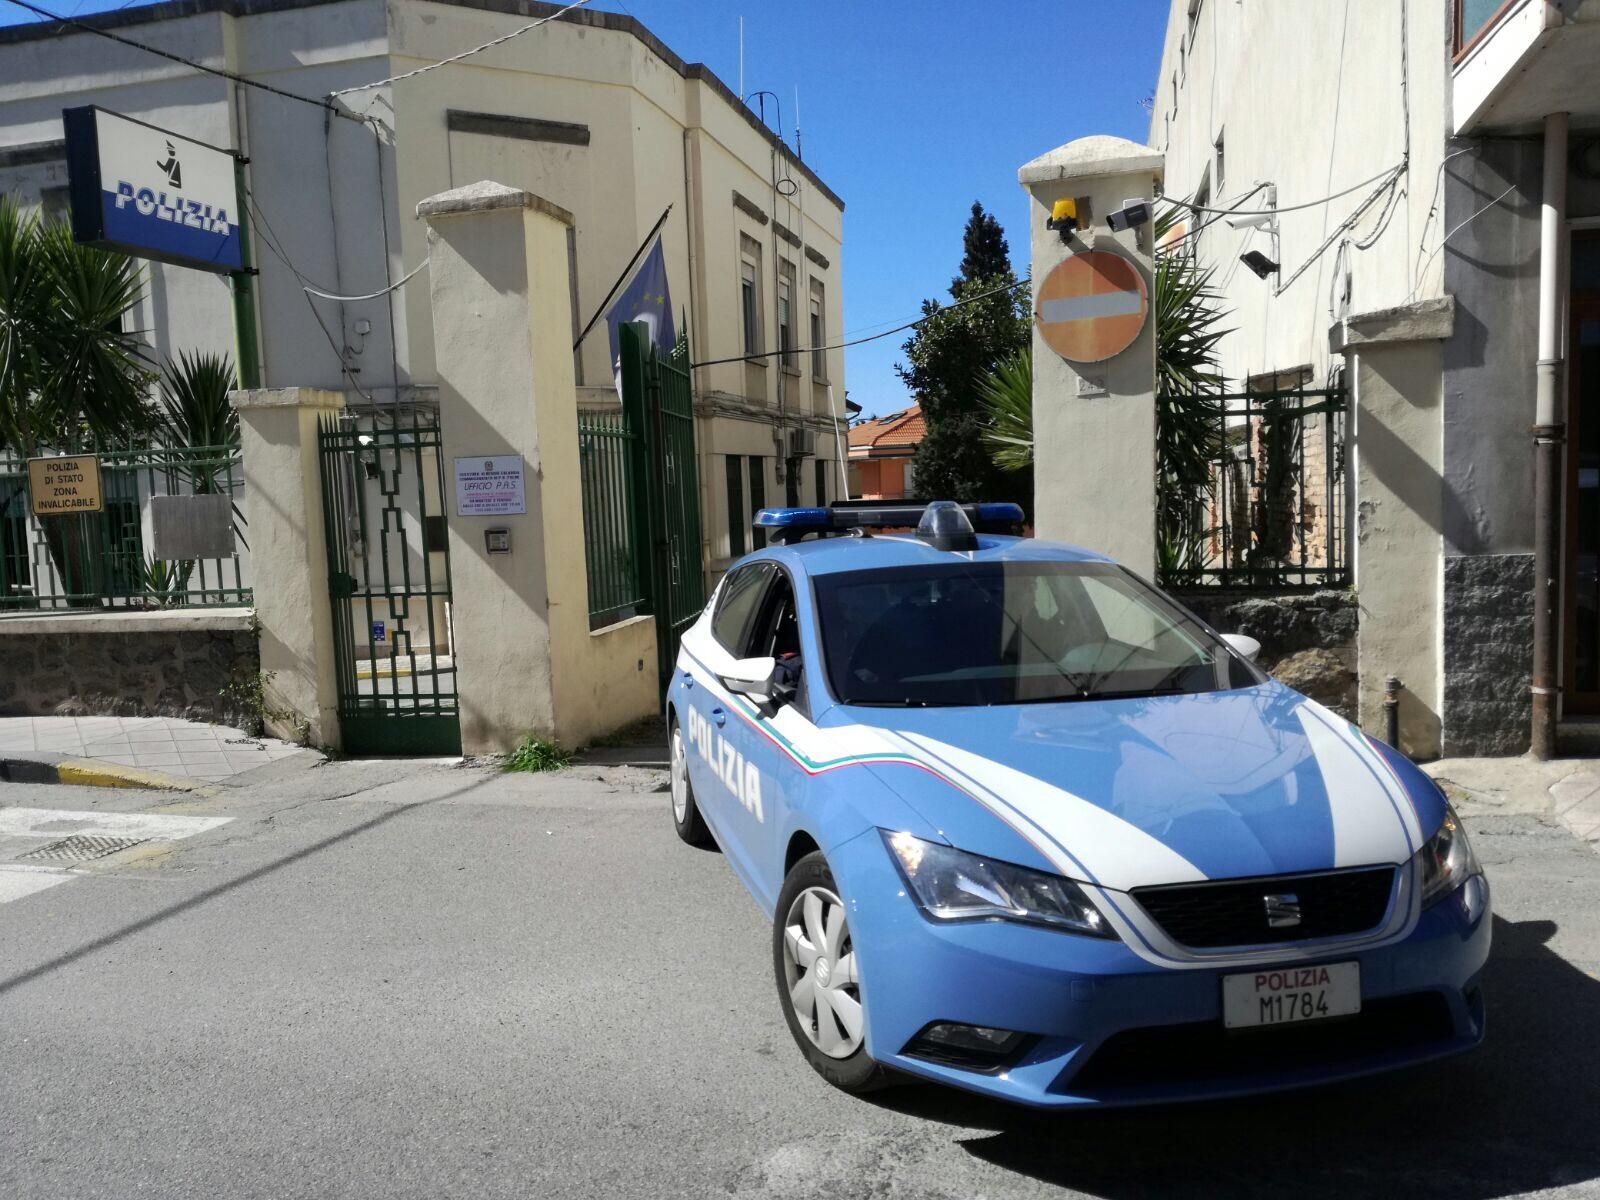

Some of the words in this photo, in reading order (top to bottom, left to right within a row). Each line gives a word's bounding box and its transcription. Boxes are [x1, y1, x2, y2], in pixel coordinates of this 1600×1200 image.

[116, 180, 230, 236] POLIZIA
[46, 462, 79, 472] POLIZIA
[44, 476, 53, 485] DI
[57, 474, 84, 484] STATO
[53, 487, 78, 497] ZONA
[464, 482, 493, 491] UFFICIO
[38, 498, 95, 510] INVALICABILE
[688, 703, 764, 824] POLIZIA
[1255, 967, 1331, 993] POLIZIA
[1259, 990, 1329, 1023] M1784
